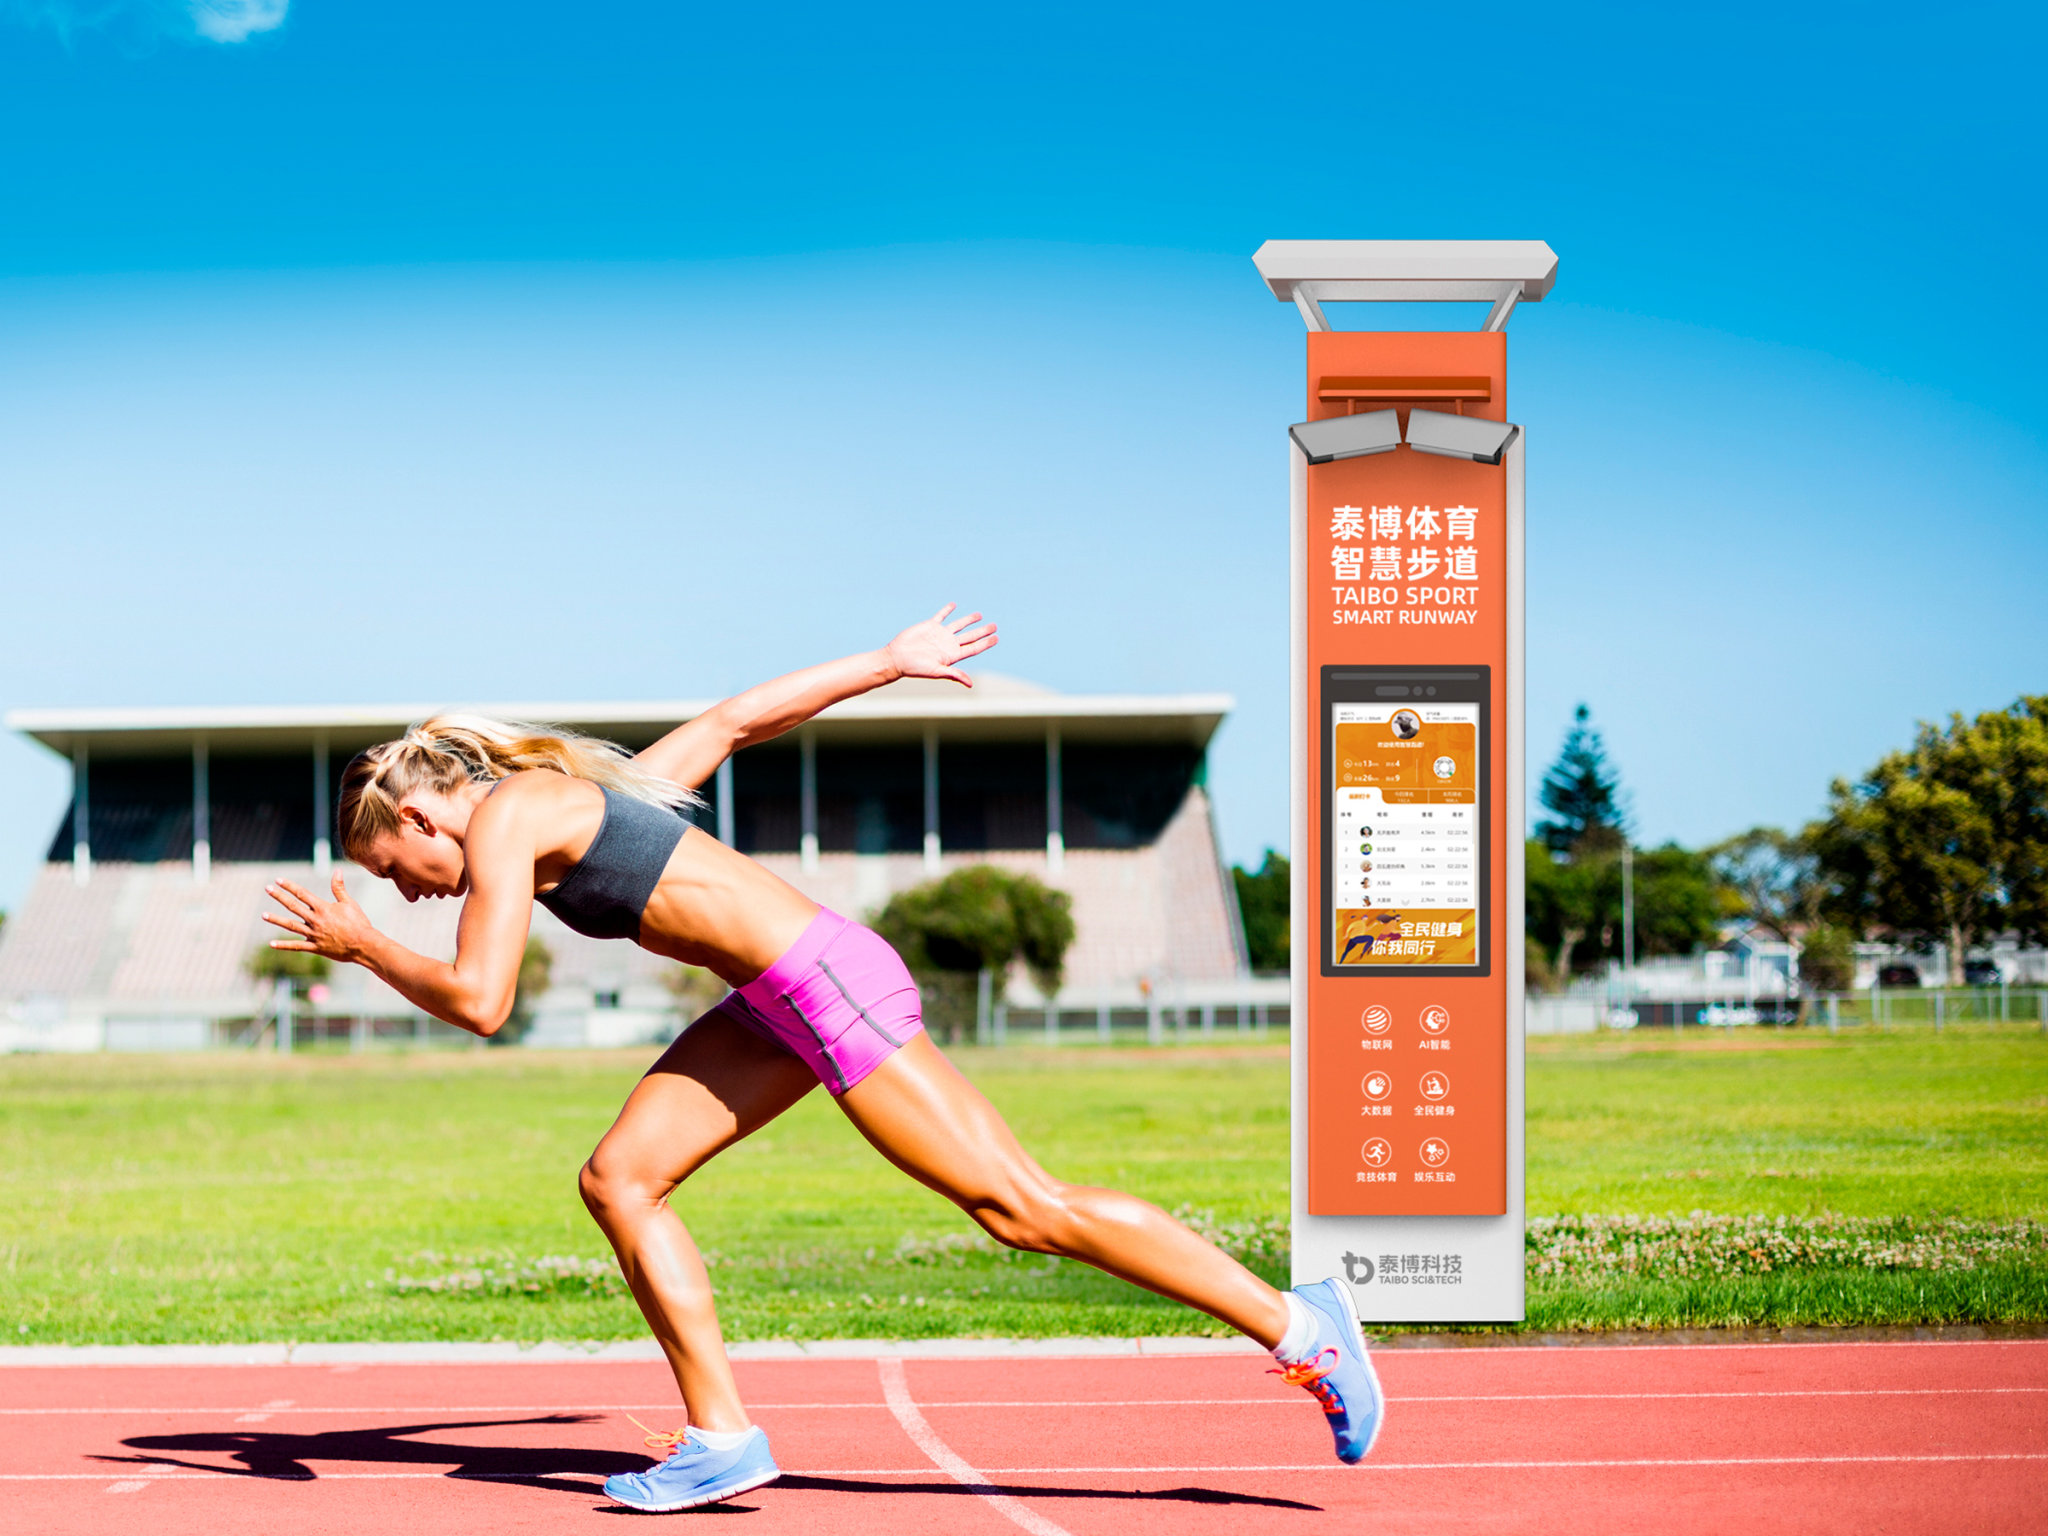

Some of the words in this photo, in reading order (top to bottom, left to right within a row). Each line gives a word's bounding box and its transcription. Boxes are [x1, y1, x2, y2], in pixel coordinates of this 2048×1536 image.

[1329, 505, 1479, 541] 泰博体育
[1330, 545, 1479, 581] 智慧步道
[1331, 586, 1399, 605] TAIBO
[1405, 586, 1479, 605] SPORT
[1332, 610, 1393, 624] SMART
[1399, 610, 1478, 624] RUNWAY
[1399, 922, 1463, 937] 全民健身
[1371, 940, 1436, 955] 你我同行
[1361, 1039, 1393, 1050] 物联网
[1419, 1039, 1451, 1050] AI智能
[1361, 1105, 1393, 1116] 大数据
[1414, 1105, 1455, 1116] 全民健身
[1356, 1172, 1397, 1183] 竞技体育
[1414, 1172, 1456, 1183] 娱乐互动
[1378, 1254, 1462, 1274] 泰博科技
[1378, 1275, 1409, 1284] TAIBO
[1411, 1275, 1462, 1284] SCI&TECH
